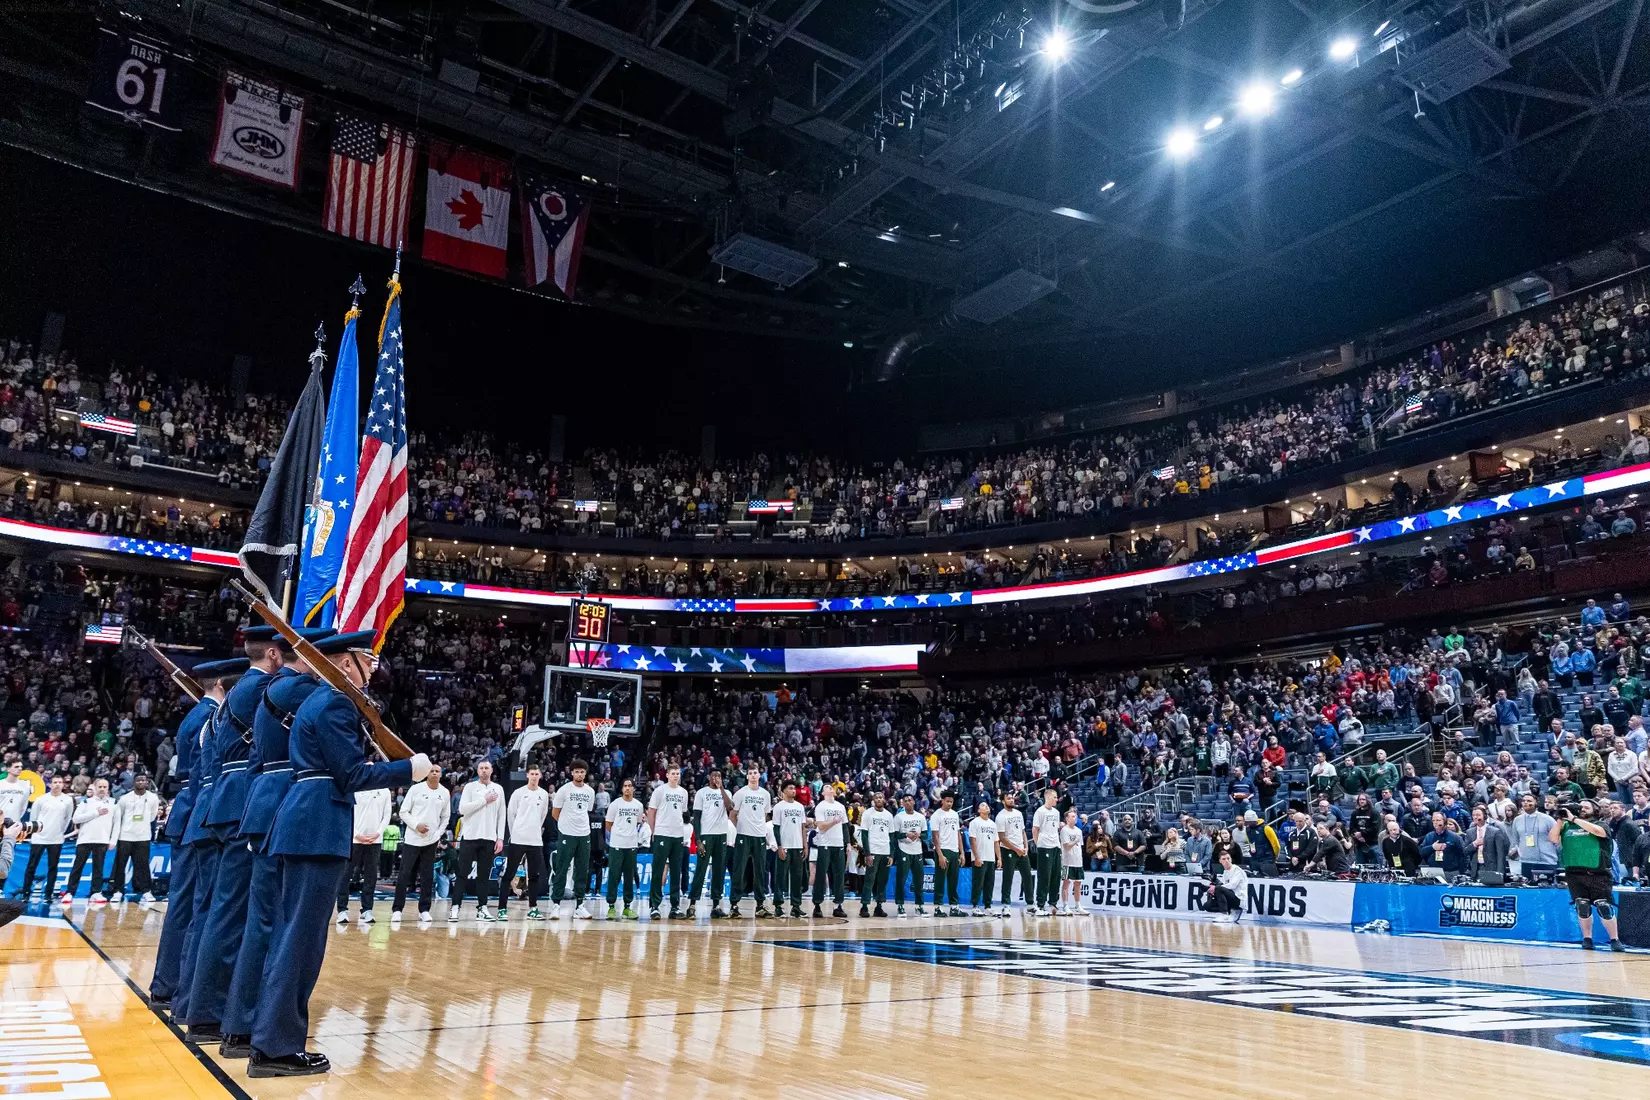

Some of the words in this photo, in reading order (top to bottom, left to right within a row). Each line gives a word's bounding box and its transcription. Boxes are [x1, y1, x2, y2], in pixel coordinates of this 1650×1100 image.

[131, 45, 162, 64] NASH
[116, 59, 166, 113] 61
[240, 131, 278, 154] JHM
[579, 603, 606, 618] 12:03
[578, 616, 602, 638] 30
[1091, 876, 1178, 911] SECOND
[1188, 881, 1308, 918] RNDS
[1453, 897, 1494, 912] MARCH
[1459, 910, 1516, 925] MADNESS
